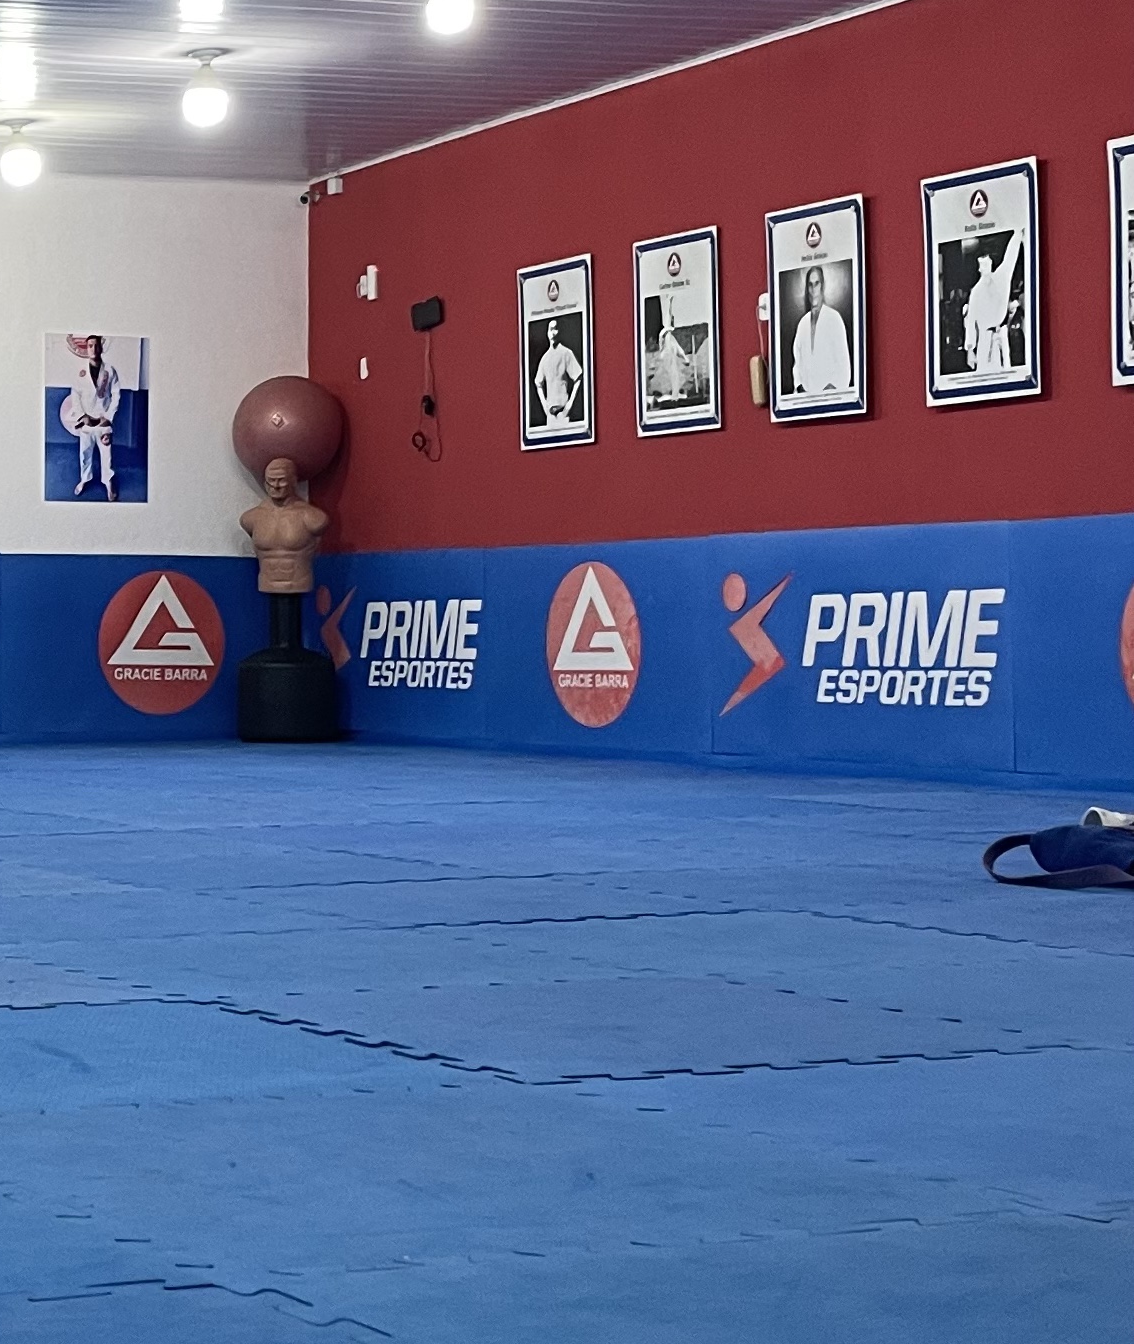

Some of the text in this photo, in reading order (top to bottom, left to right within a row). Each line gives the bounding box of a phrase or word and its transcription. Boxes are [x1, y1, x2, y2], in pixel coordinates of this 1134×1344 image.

[360, 598, 483, 660] PRIME
[801, 587, 1006, 668] PRIME
[113, 667, 208, 681] GRACIE BARRA
[367, 660, 474, 690] ESPORTES
[557, 673, 629, 689] GRACIE BARRA
[816, 668, 993, 707] ESPORTES
